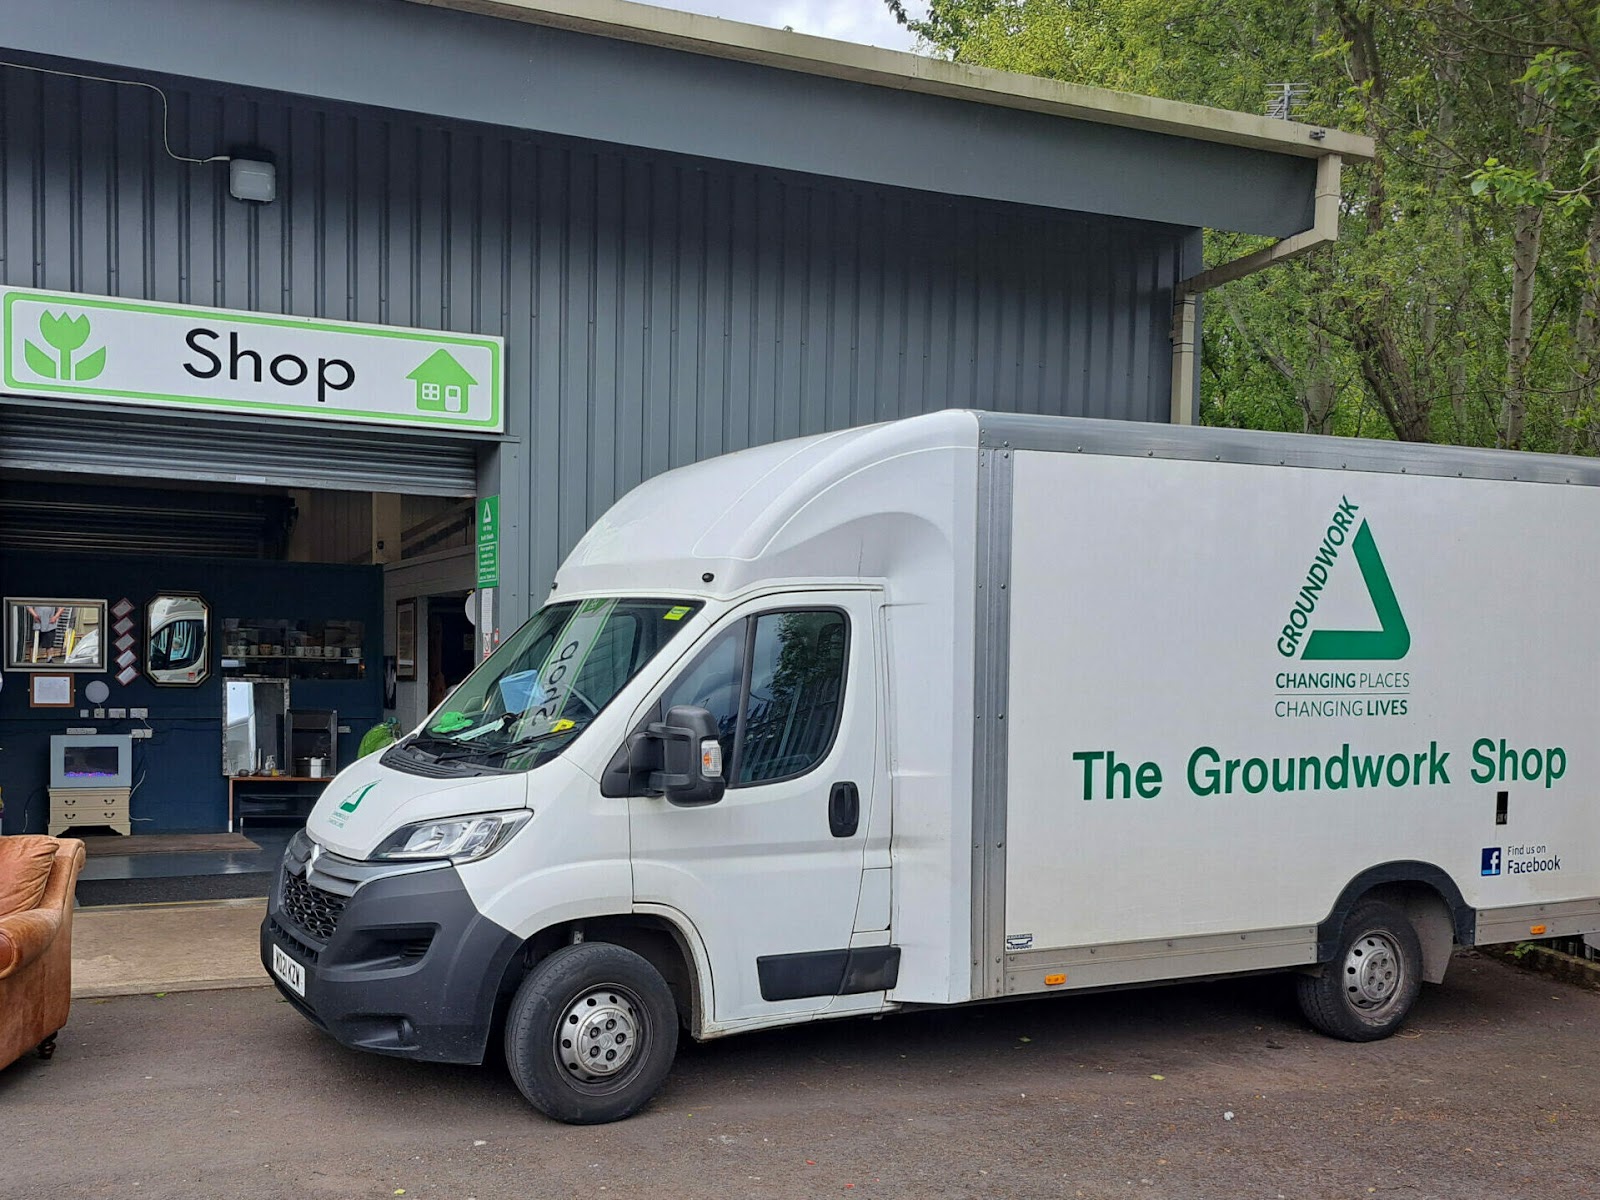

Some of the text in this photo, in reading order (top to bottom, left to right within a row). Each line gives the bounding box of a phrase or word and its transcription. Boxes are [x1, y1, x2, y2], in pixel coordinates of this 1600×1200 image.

[183, 328, 356, 402] Shop
[1277, 495, 1359, 657] GROUNDWORK
[1275, 672, 1410, 689] CHANGING PLACES
[1274, 699, 1408, 718] CHANGING LIVES
[1072, 737, 1567, 801] The Groundwork Shop
[1507, 844, 1547, 856] Find us on
[1507, 855, 1561, 874] Facebook
